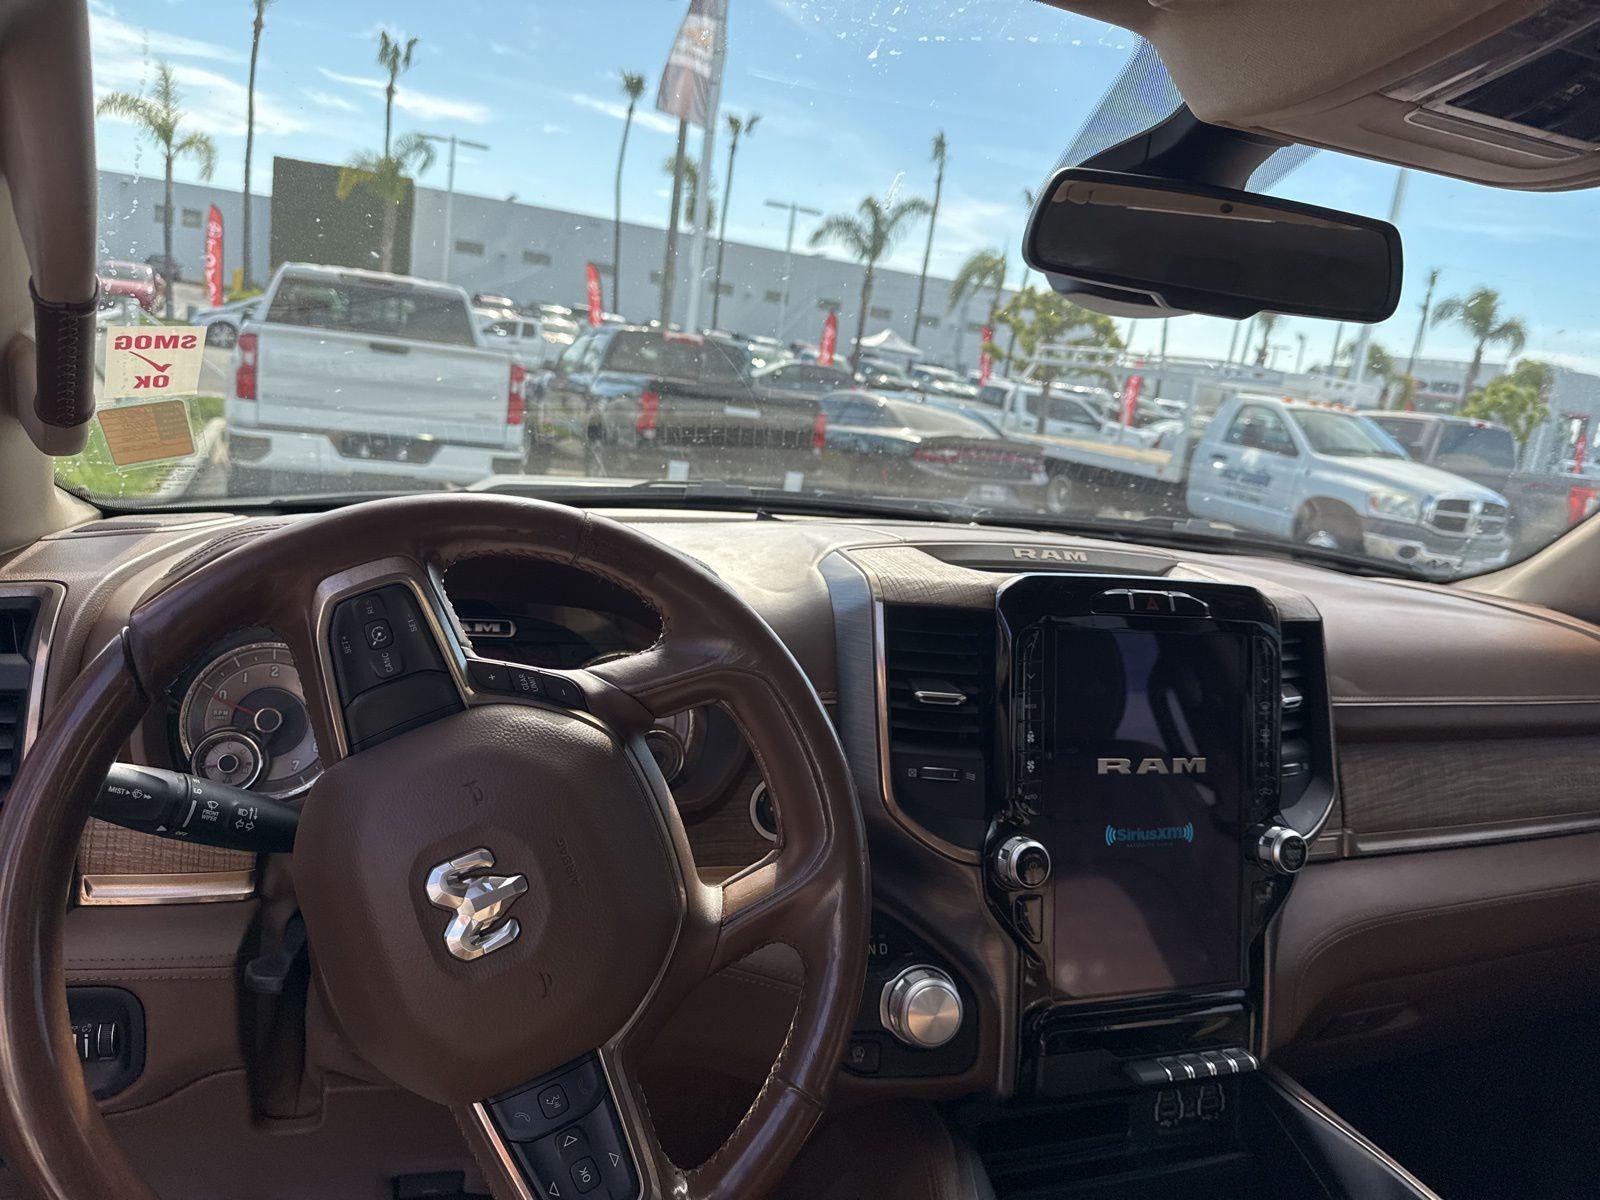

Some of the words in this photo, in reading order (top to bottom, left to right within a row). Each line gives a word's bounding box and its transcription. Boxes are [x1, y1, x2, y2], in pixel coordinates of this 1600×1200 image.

[1013, 547, 1088, 562] RAM
[271, 666, 280, 677] 2
[243, 672, 248, 683] 1
[518, 672, 530, 691] GEAR
[528, 675, 540, 693] LIMIT
[292, 760, 300, 770] 7
[1097, 757, 1207, 774] RAM
[108, 786, 126, 796] MIST
[201, 814, 218, 822] WIPER
[202, 809, 220, 817] FRONT
[577, 1166, 591, 1184] OK
